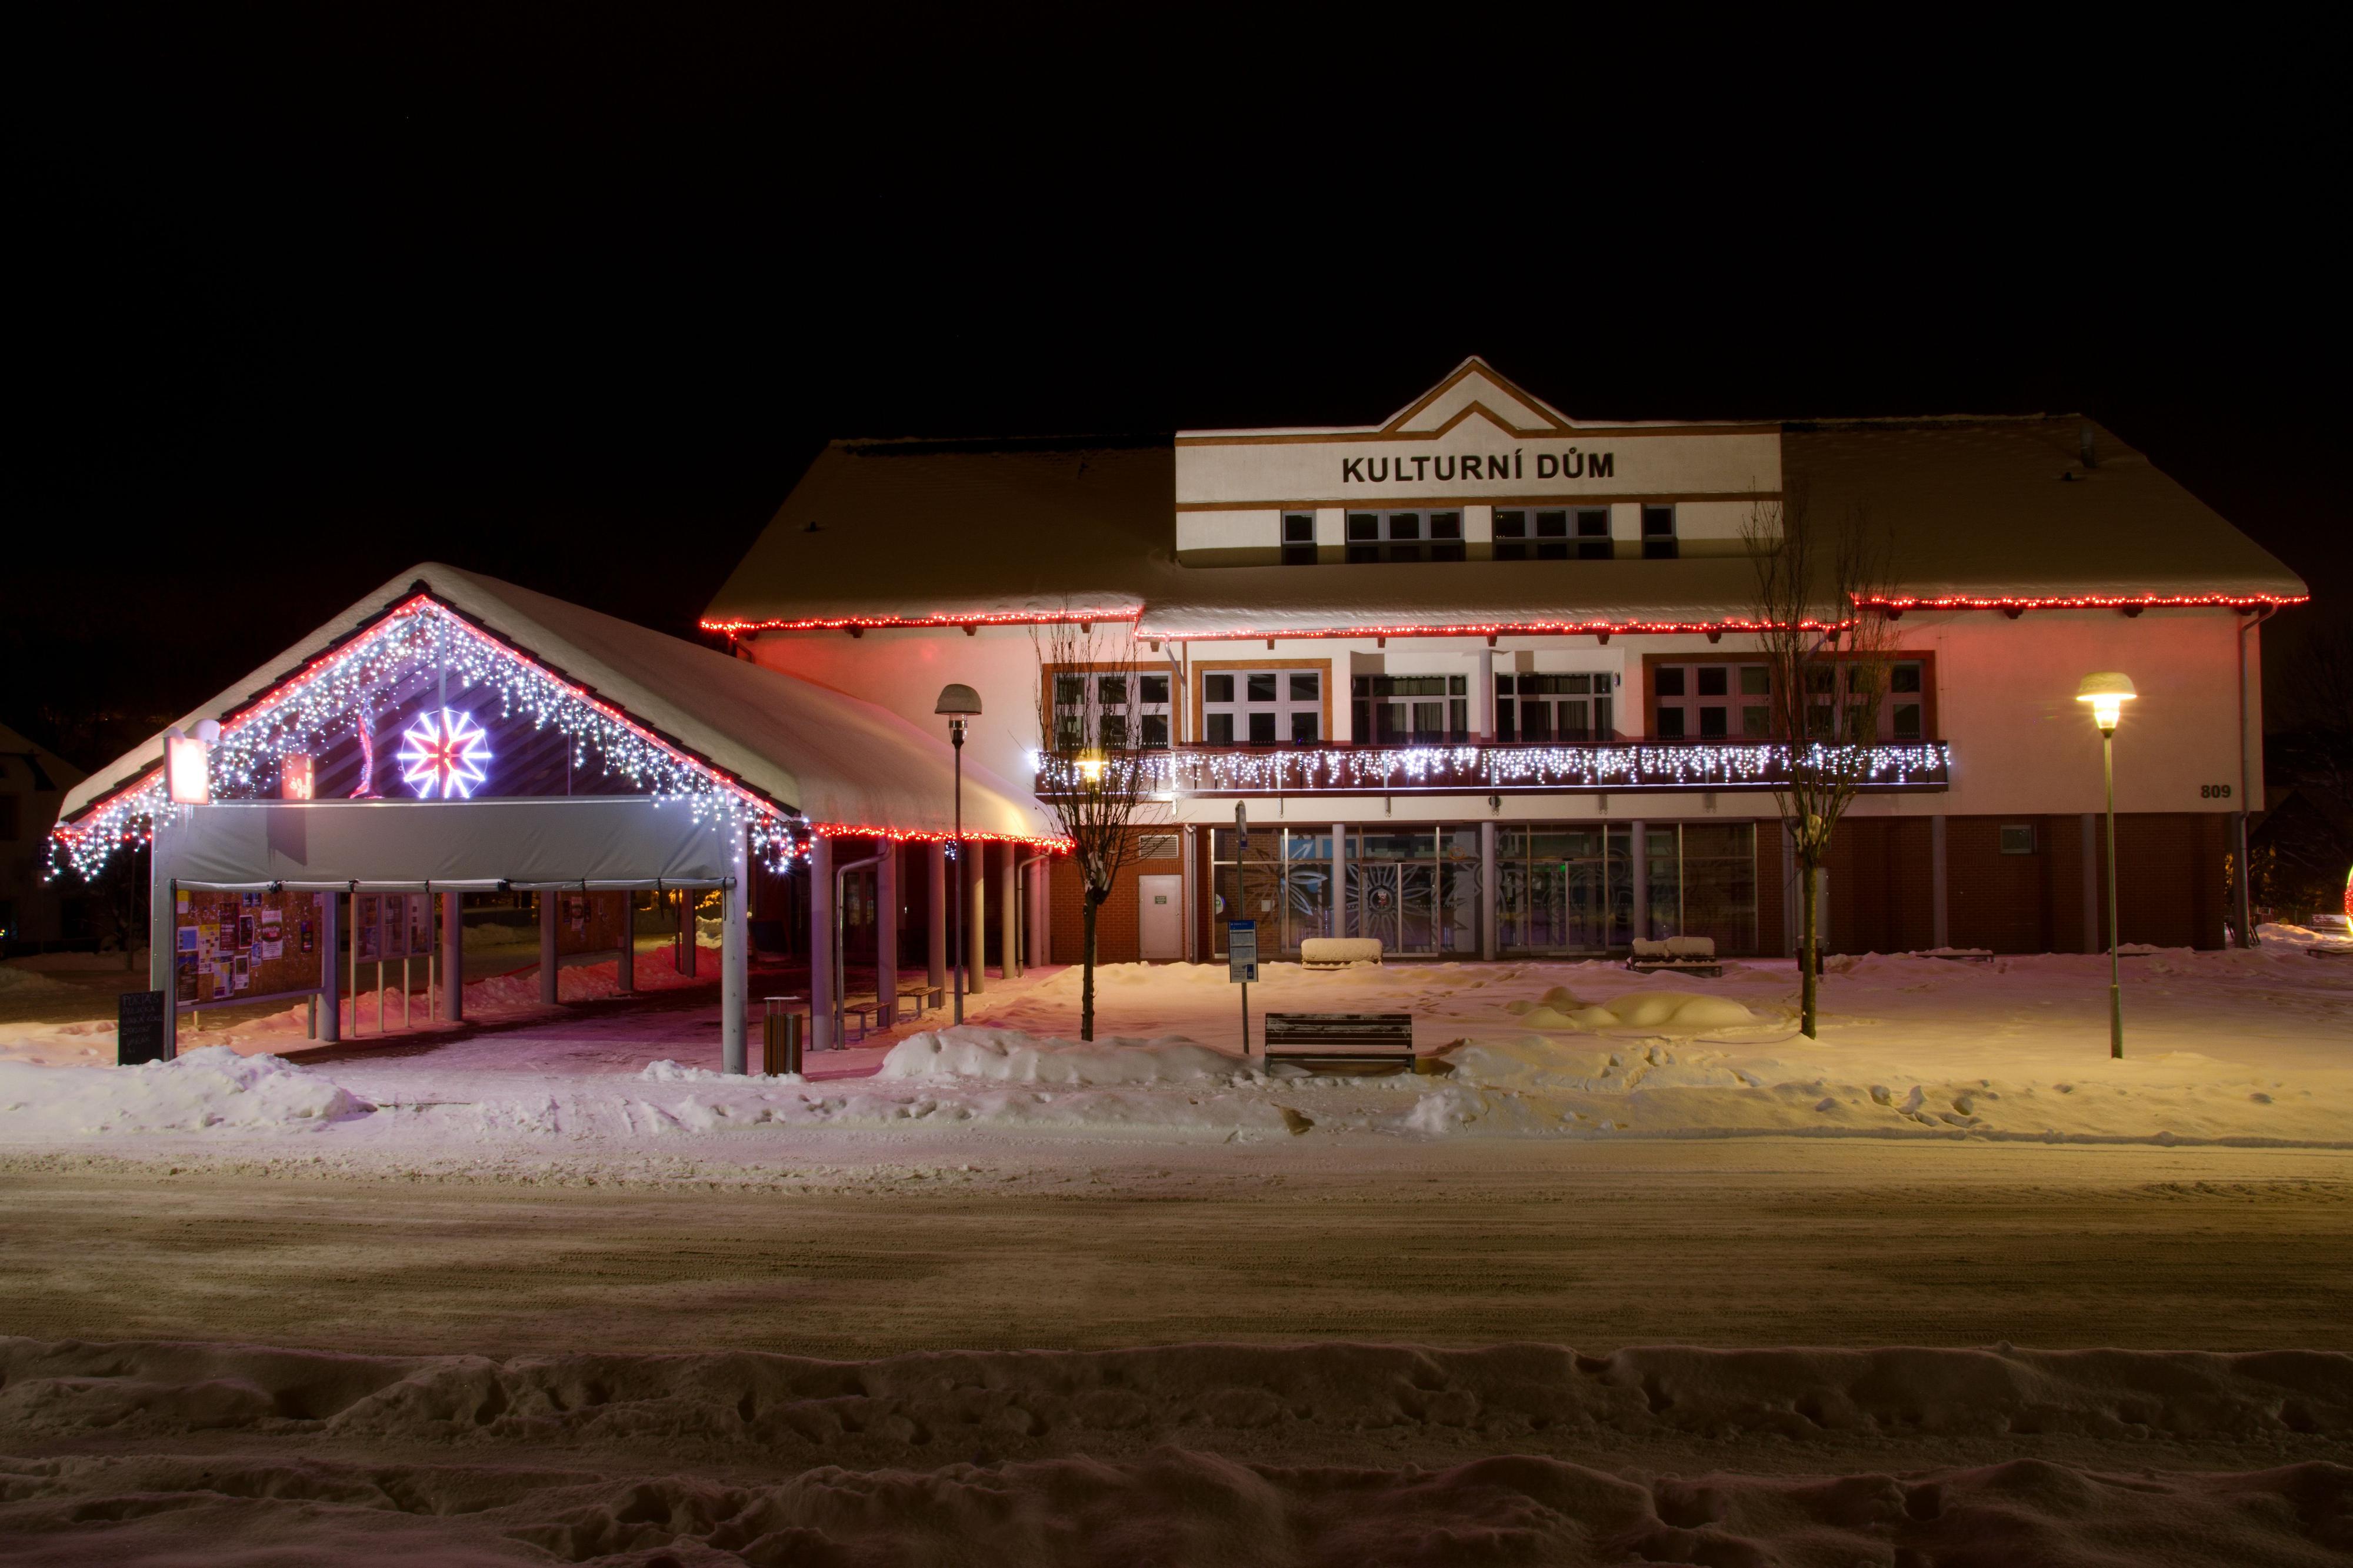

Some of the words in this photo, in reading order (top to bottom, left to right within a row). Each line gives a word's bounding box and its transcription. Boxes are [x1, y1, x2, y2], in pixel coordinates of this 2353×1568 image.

[1342, 448, 1522, 483] KULTURNÍ
[1537, 447, 1614, 479] DŮM
[2201, 784, 2232, 799] 809
